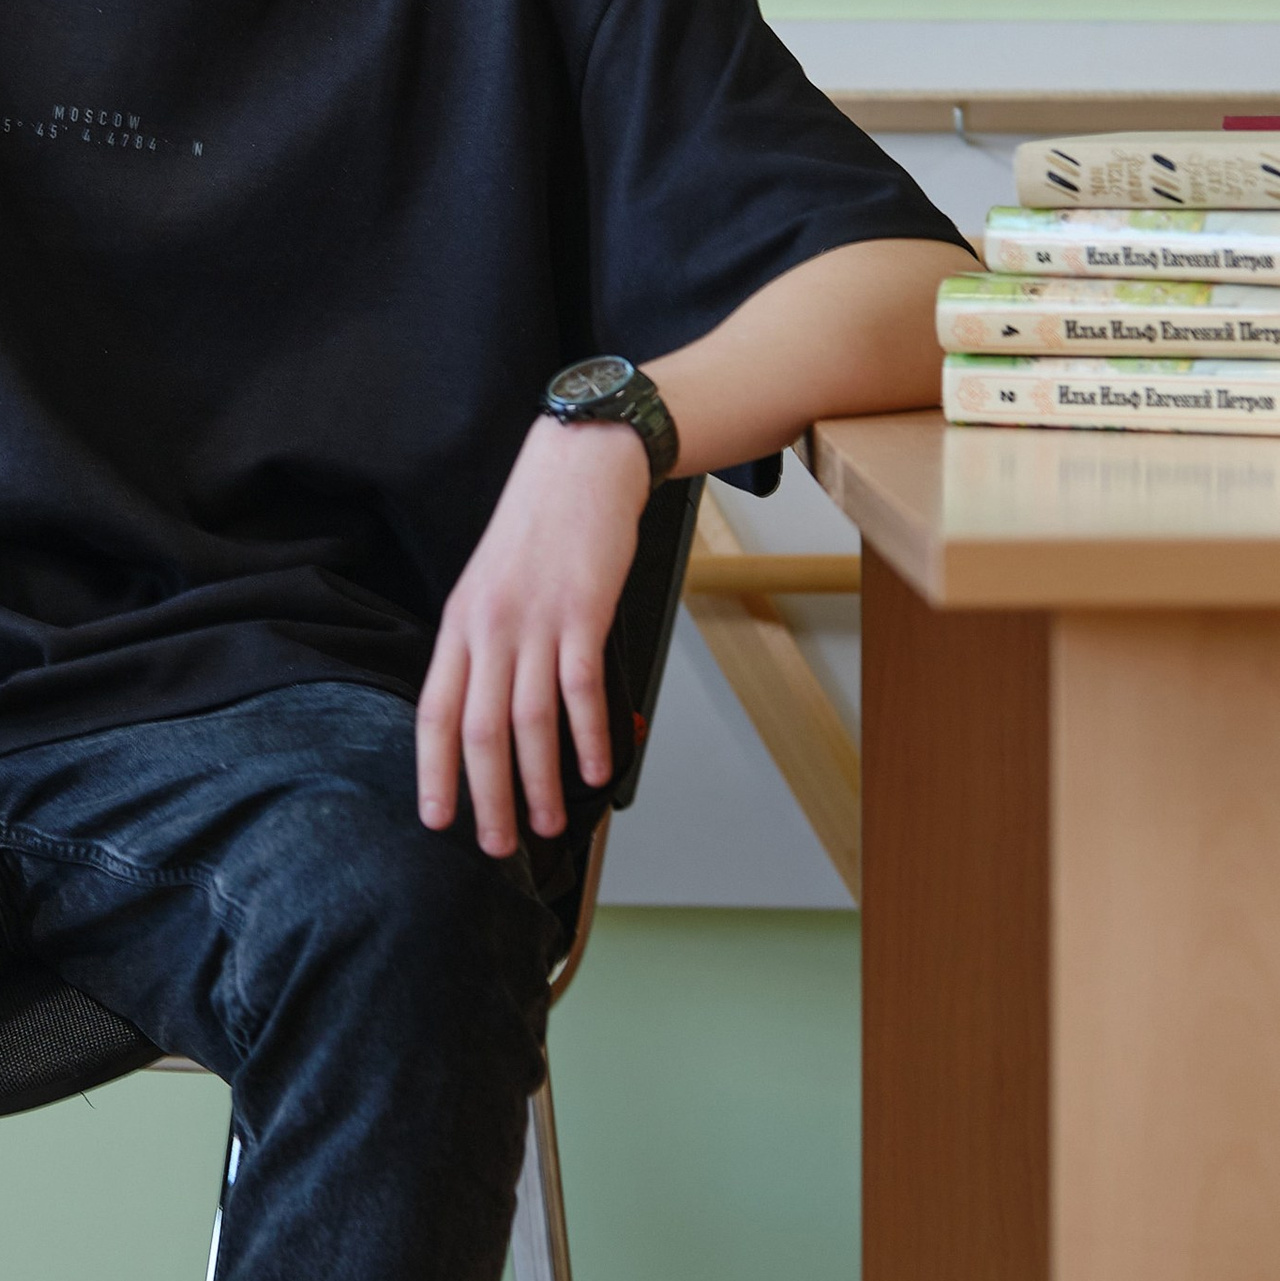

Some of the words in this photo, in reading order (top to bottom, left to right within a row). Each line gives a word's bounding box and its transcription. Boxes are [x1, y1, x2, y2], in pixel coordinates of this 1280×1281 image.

[52, 104, 141, 131] MOSCOW
[192, 140, 204, 157] N
[1086, 245, 1119, 266] Илья
[1122, 245, 1159, 270] Ильф
[1160, 246, 1220, 268] Евгений
[1223, 248, 1275, 271] Петров
[1065, 319, 1107, 340] Илья
[1111, 320, 1156, 343] Ильф
[1161, 320, 1235, 341] Евгений
[1058, 384, 1096, 405] Илья
[1100, 385, 1140, 409] Ильф
[1145, 387, 1212, 409] Евгений
[1217, 389, 1274, 412] Петров
